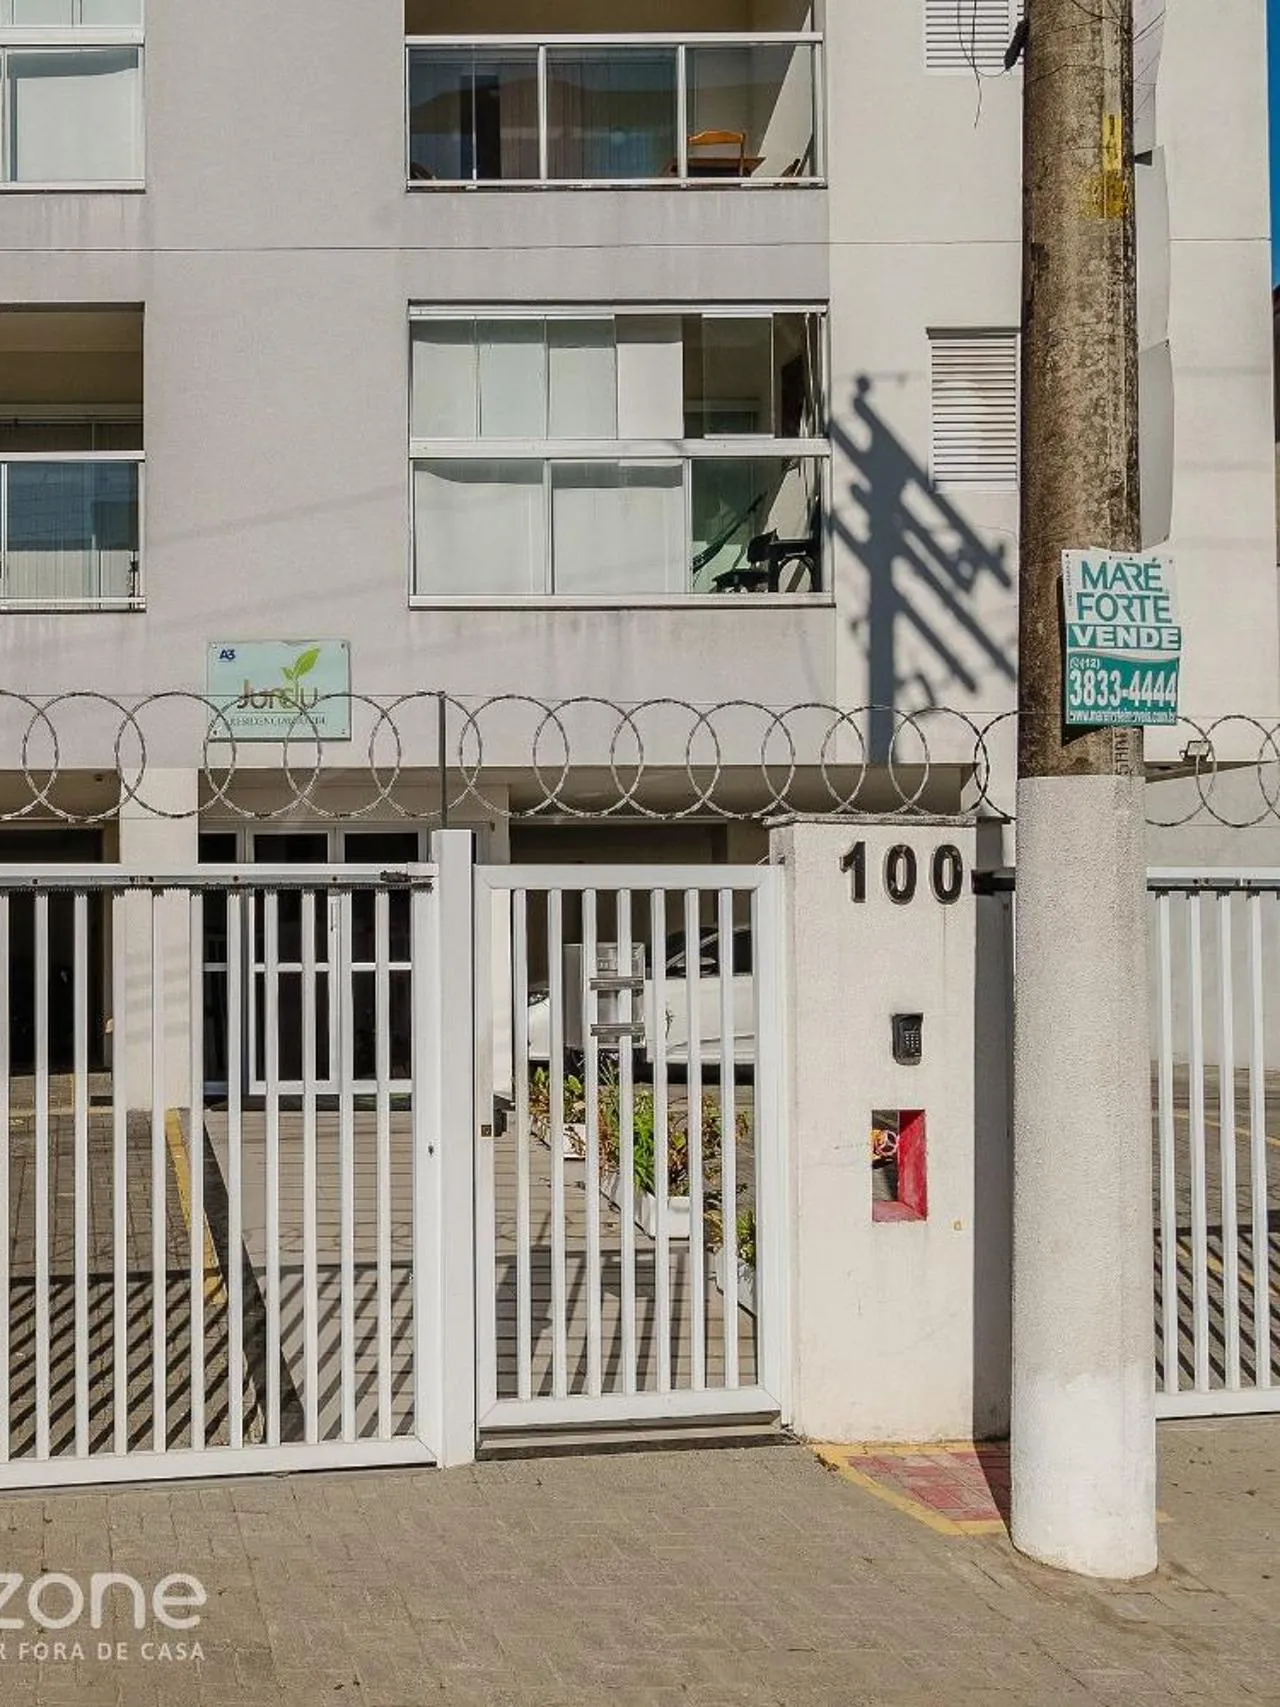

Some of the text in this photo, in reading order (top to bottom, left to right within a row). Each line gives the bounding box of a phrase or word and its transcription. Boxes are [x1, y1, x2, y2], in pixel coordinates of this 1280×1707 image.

[1081, 557, 1163, 592] MARÉ
[1077, 592, 1173, 623] FORTE
[1072, 626, 1180, 649] VENDE
[1069, 669, 1177, 708] 3833-4444
[839, 841, 964, 904] 100
